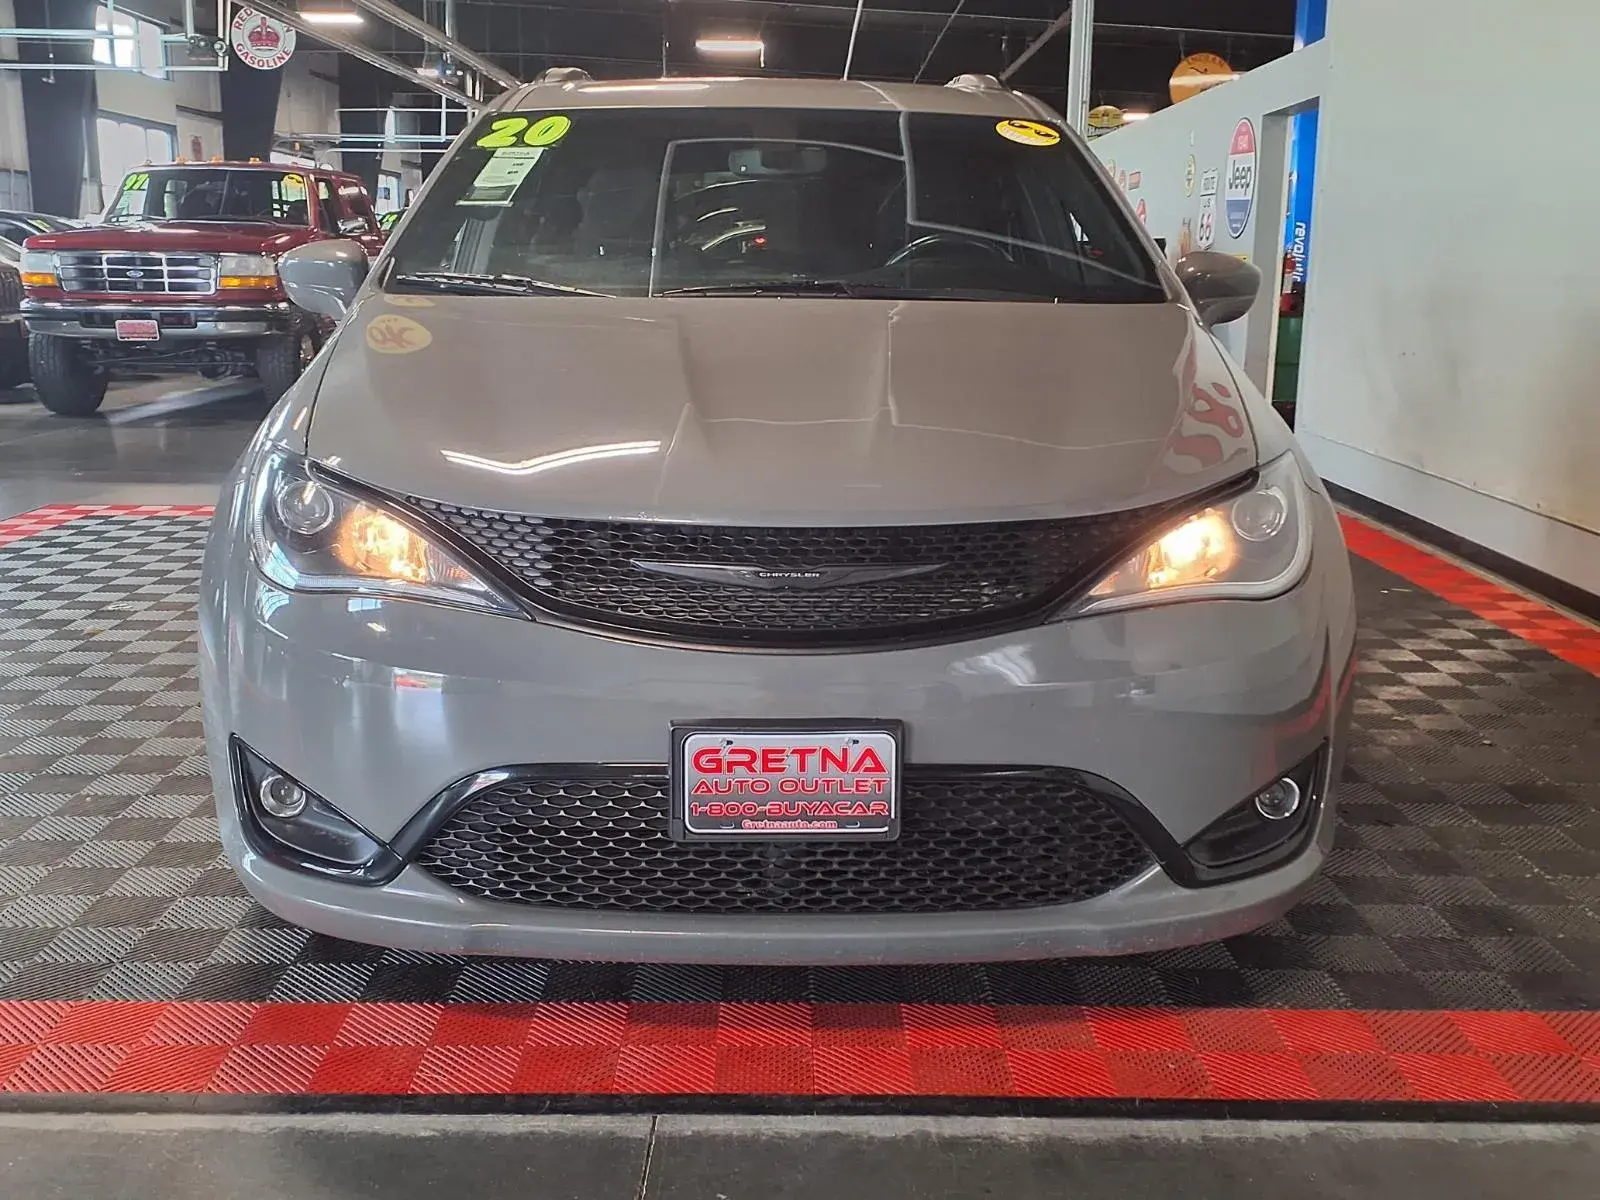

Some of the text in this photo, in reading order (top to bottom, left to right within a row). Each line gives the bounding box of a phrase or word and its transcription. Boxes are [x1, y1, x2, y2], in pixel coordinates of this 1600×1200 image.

[233, 7, 253, 30] RED
[235, 43, 292, 68] GASOLINE
[476, 116, 571, 148] 20
[1228, 160, 1252, 196] Jeep
[1199, 213, 1212, 241] 66
[691, 746, 889, 775] GRETNA
[691, 778, 889, 795] AUTO OUTLET
[690, 801, 889, 817] 1-800-BUYACAR
[742, 819, 838, 830] Gretnaauto.com
